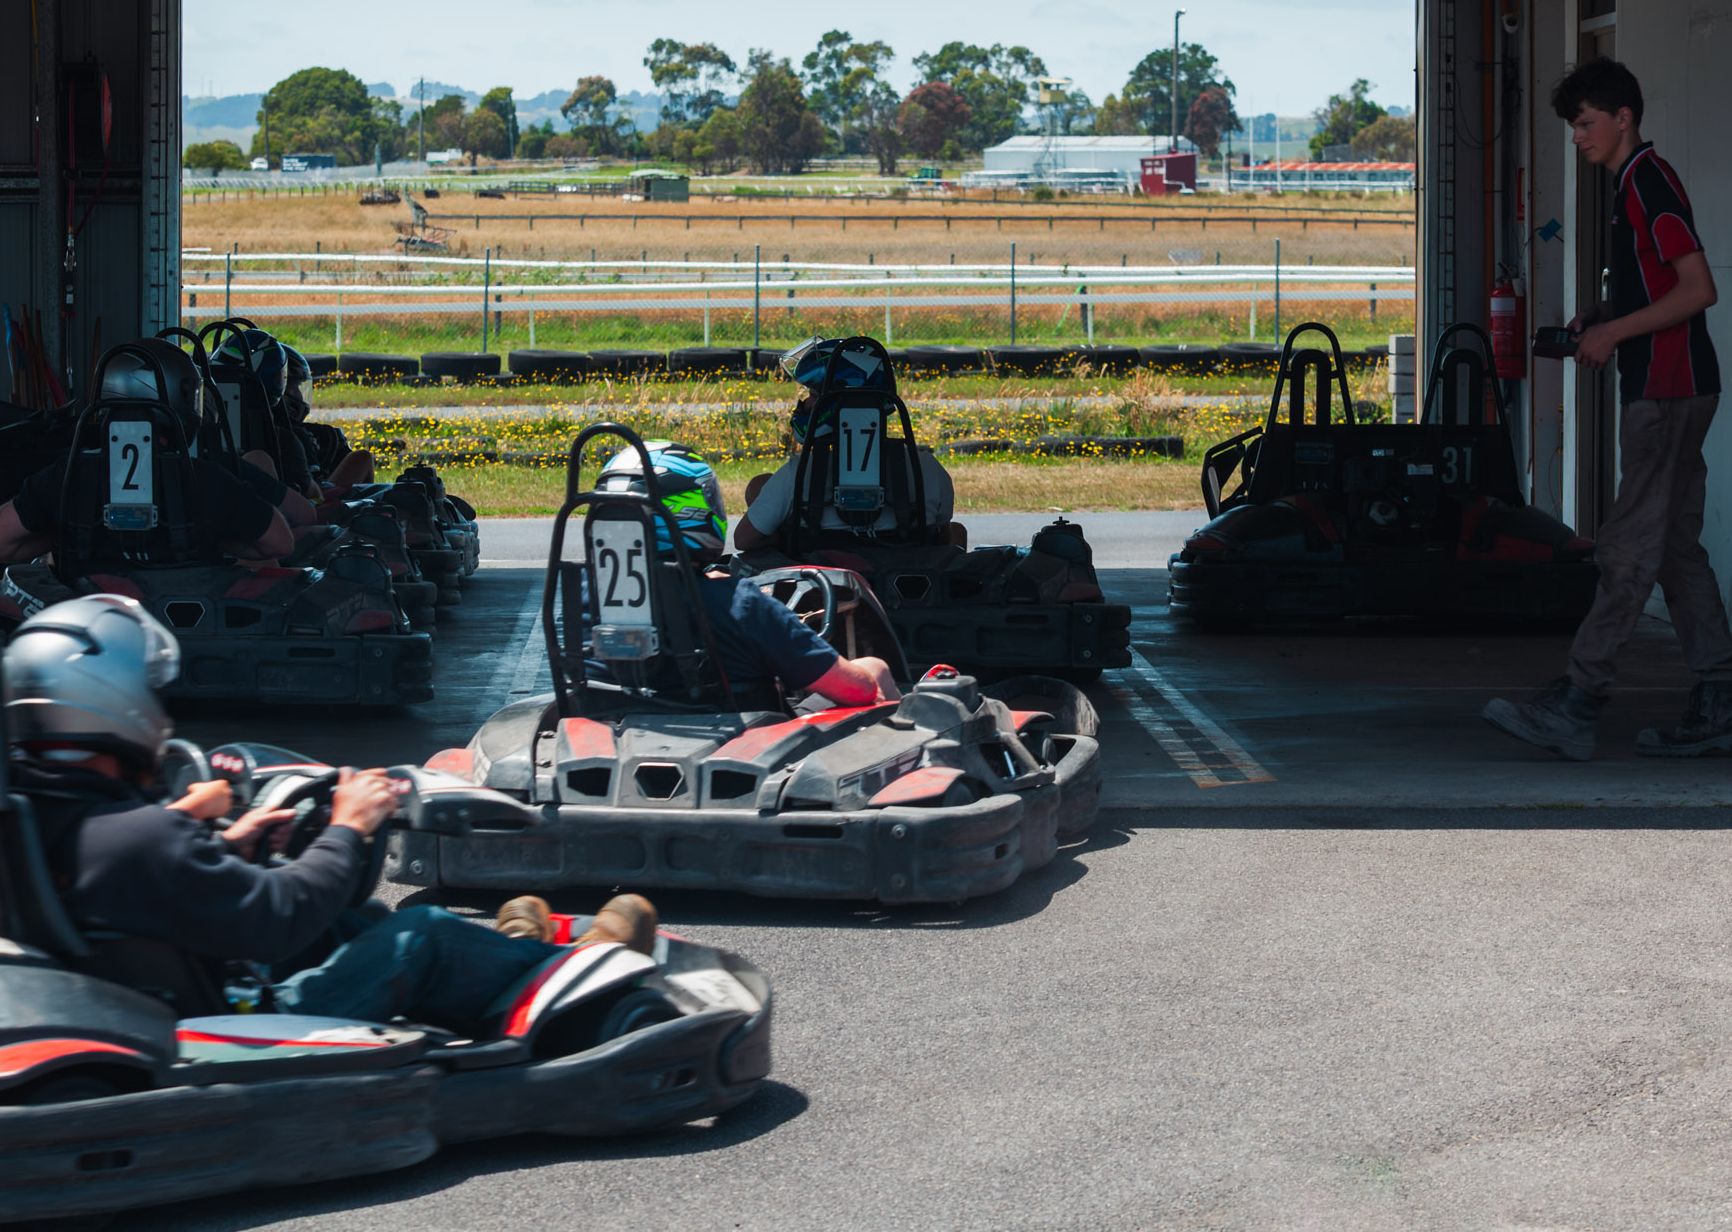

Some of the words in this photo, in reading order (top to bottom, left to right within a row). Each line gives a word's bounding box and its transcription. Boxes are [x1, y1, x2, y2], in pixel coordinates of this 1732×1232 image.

[122, 443, 139, 490] 2
[844, 429, 876, 472] 17
[1441, 446, 1472, 484] 31
[599, 548, 646, 608] 25
